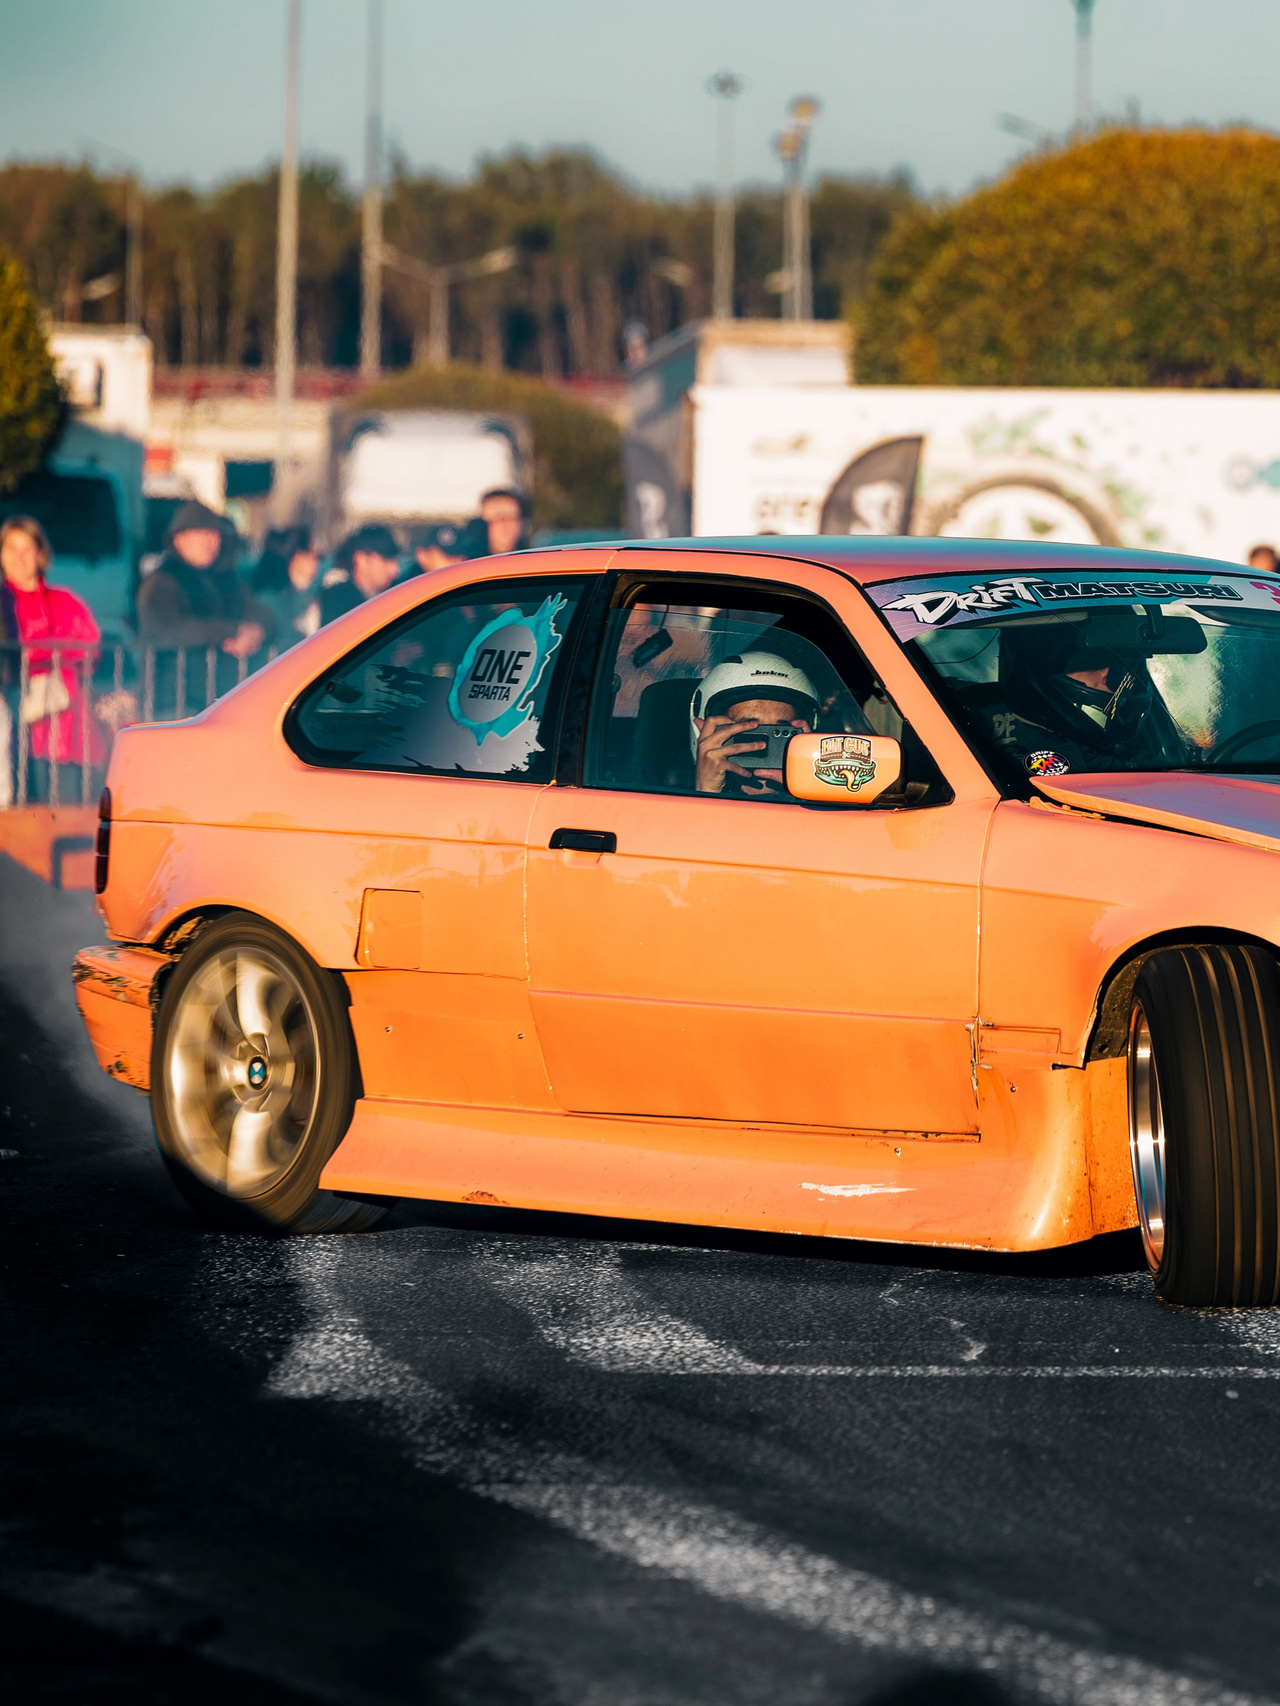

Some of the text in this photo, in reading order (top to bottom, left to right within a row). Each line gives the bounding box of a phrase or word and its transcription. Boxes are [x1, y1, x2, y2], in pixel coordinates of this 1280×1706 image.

[1032, 581, 1244, 601] MATSURI
[469, 648, 532, 685] ONE
[468, 684, 512, 701] SPARTA
[822, 737, 870, 756] KIT CUT
[1030, 750, 1055, 758] DRIFT
